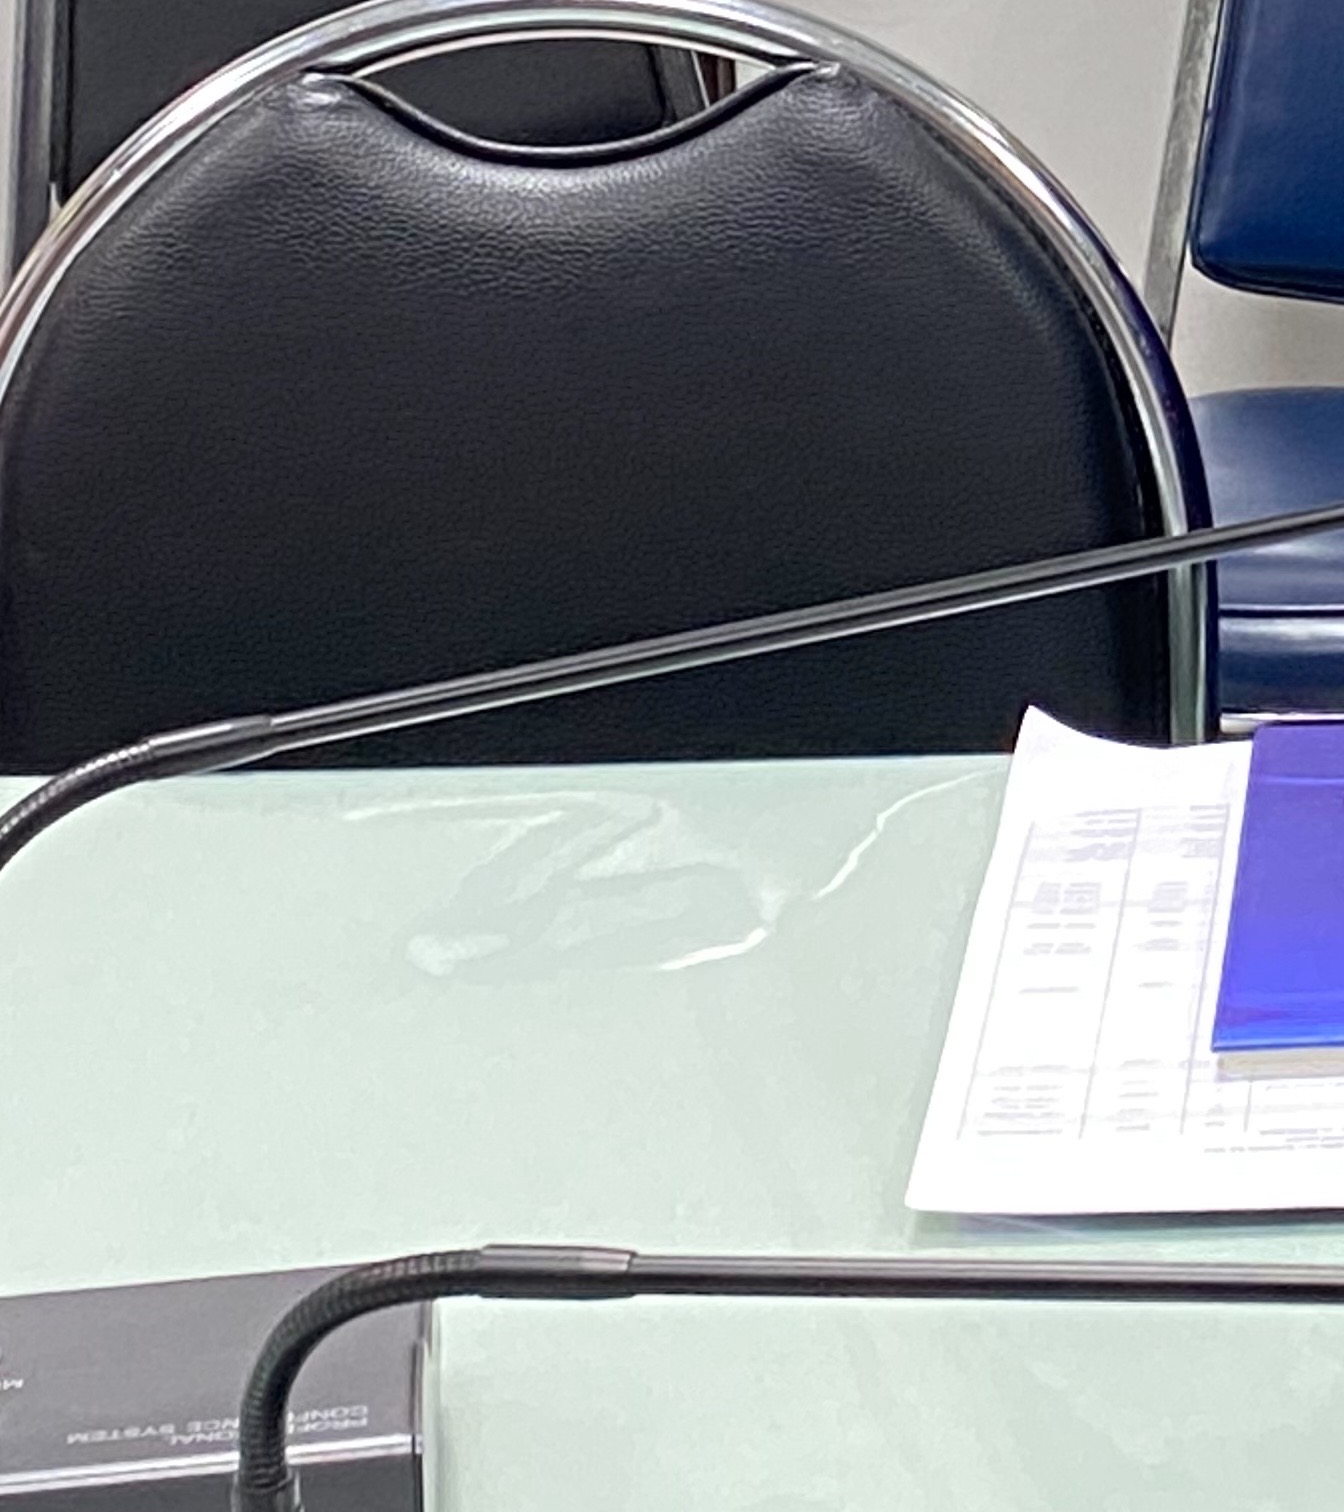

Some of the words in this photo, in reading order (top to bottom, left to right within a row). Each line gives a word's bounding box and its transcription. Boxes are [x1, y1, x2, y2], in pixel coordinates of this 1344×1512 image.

[170, 1417, 369, 1446] PROFONAL
[187, 1405, 369, 1433] CONFNCE
[66, 1422, 176, 1445] SYSTEM
